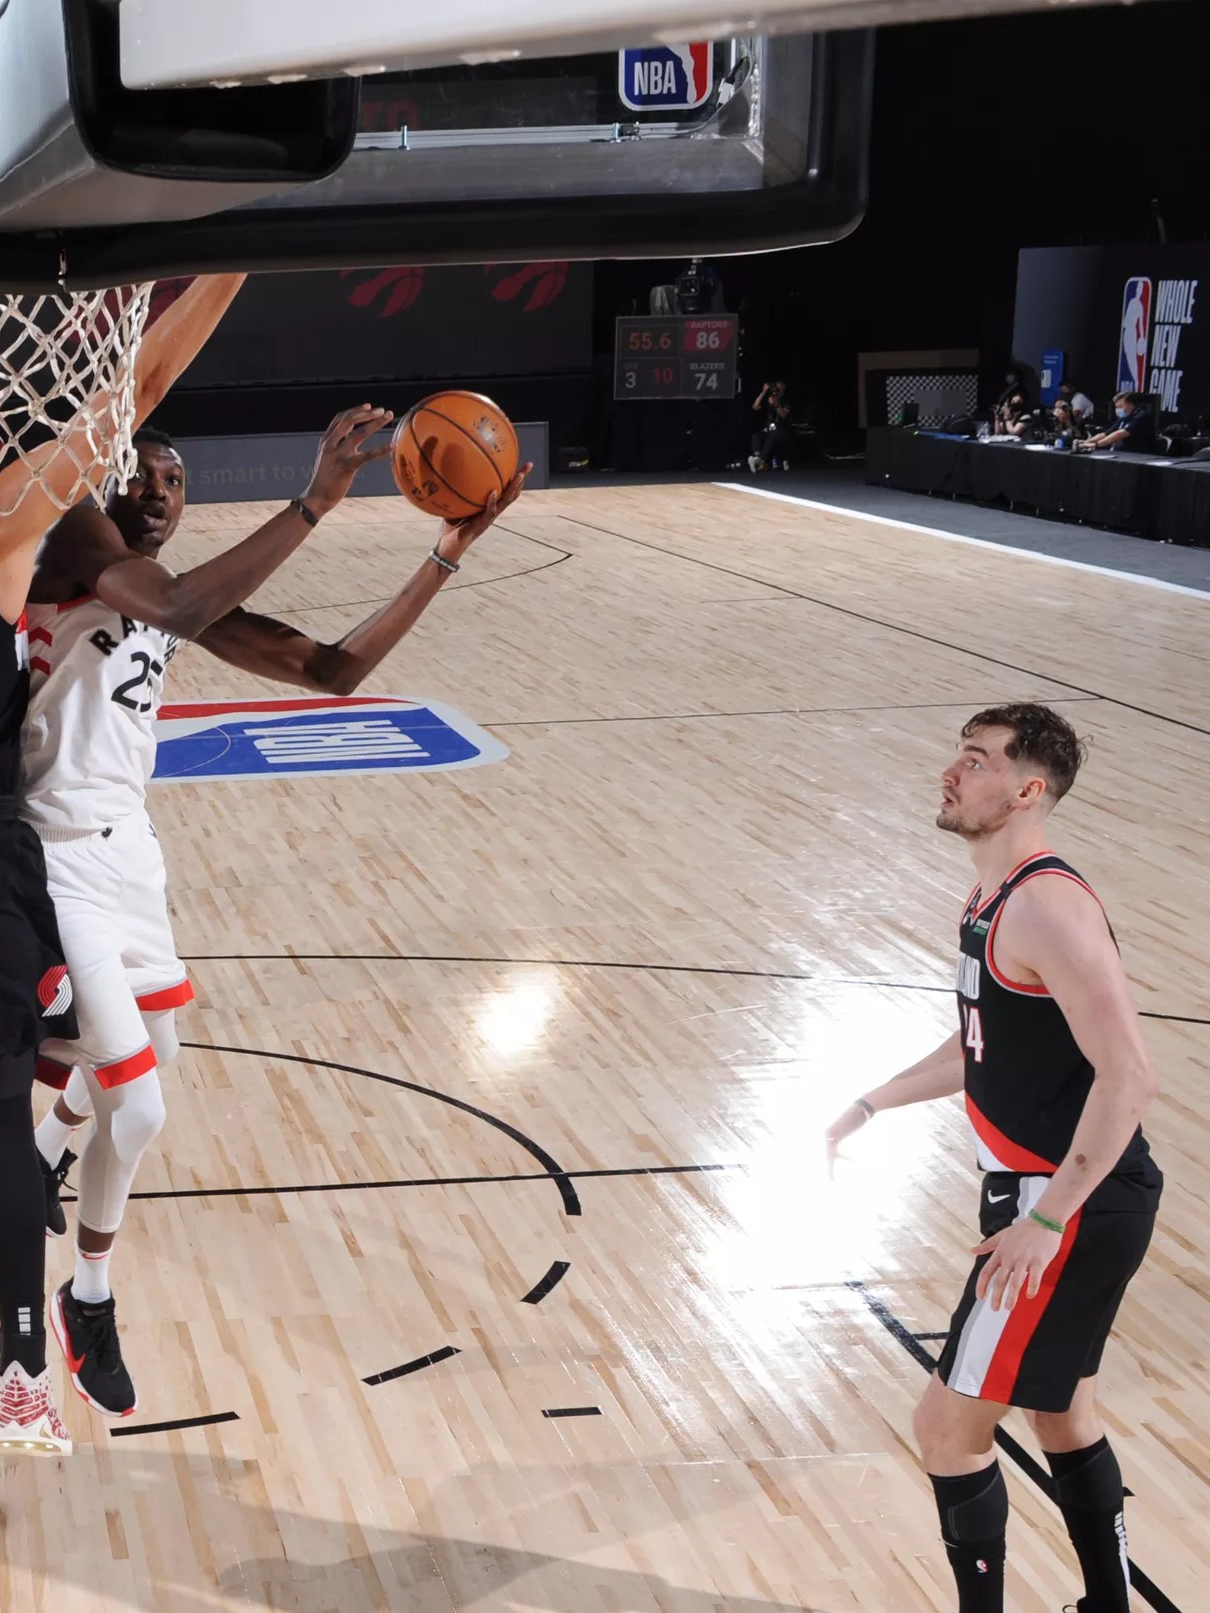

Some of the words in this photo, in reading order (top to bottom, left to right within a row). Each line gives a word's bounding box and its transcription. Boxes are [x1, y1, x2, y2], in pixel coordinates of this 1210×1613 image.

[633, 60, 677, 96] NBA
[1154, 279, 1199, 324] WHOLE
[629, 332, 673, 350] 55.6
[695, 331, 720, 349] 86
[1150, 325, 1182, 368] NEW
[625, 371, 637, 389] 3
[653, 367, 674, 384] 10
[694, 372, 718, 391] 74
[200, 462, 267, 486] smart
[273, 461, 295, 481] to
[243, 720, 431, 764] NBA
